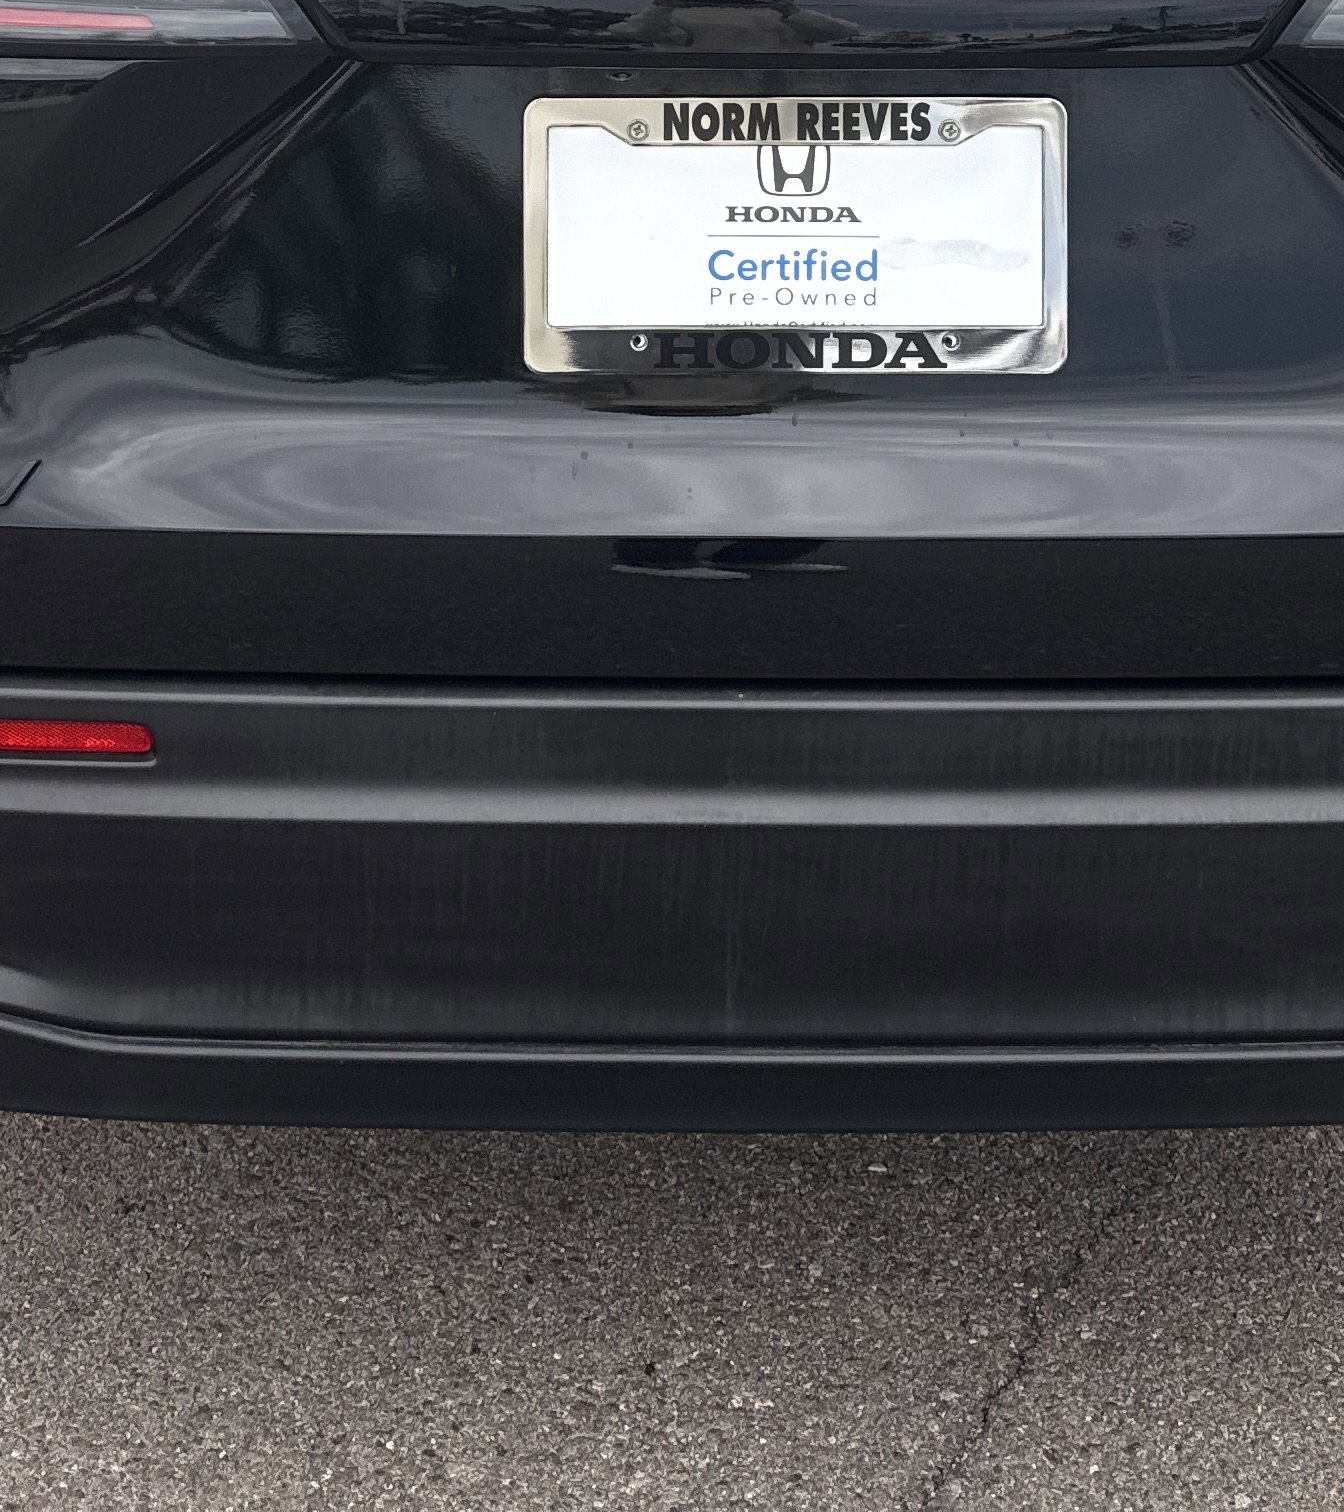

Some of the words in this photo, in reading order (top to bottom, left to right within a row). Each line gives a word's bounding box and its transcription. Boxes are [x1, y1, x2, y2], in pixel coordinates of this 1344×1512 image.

[663, 102, 781, 142] NORM
[796, 103, 932, 142] REEVES
[725, 206, 862, 223] HONDA
[708, 249, 879, 282] Certified
[709, 287, 878, 307] Pre-Owned
[654, 331, 947, 370] HONDA
